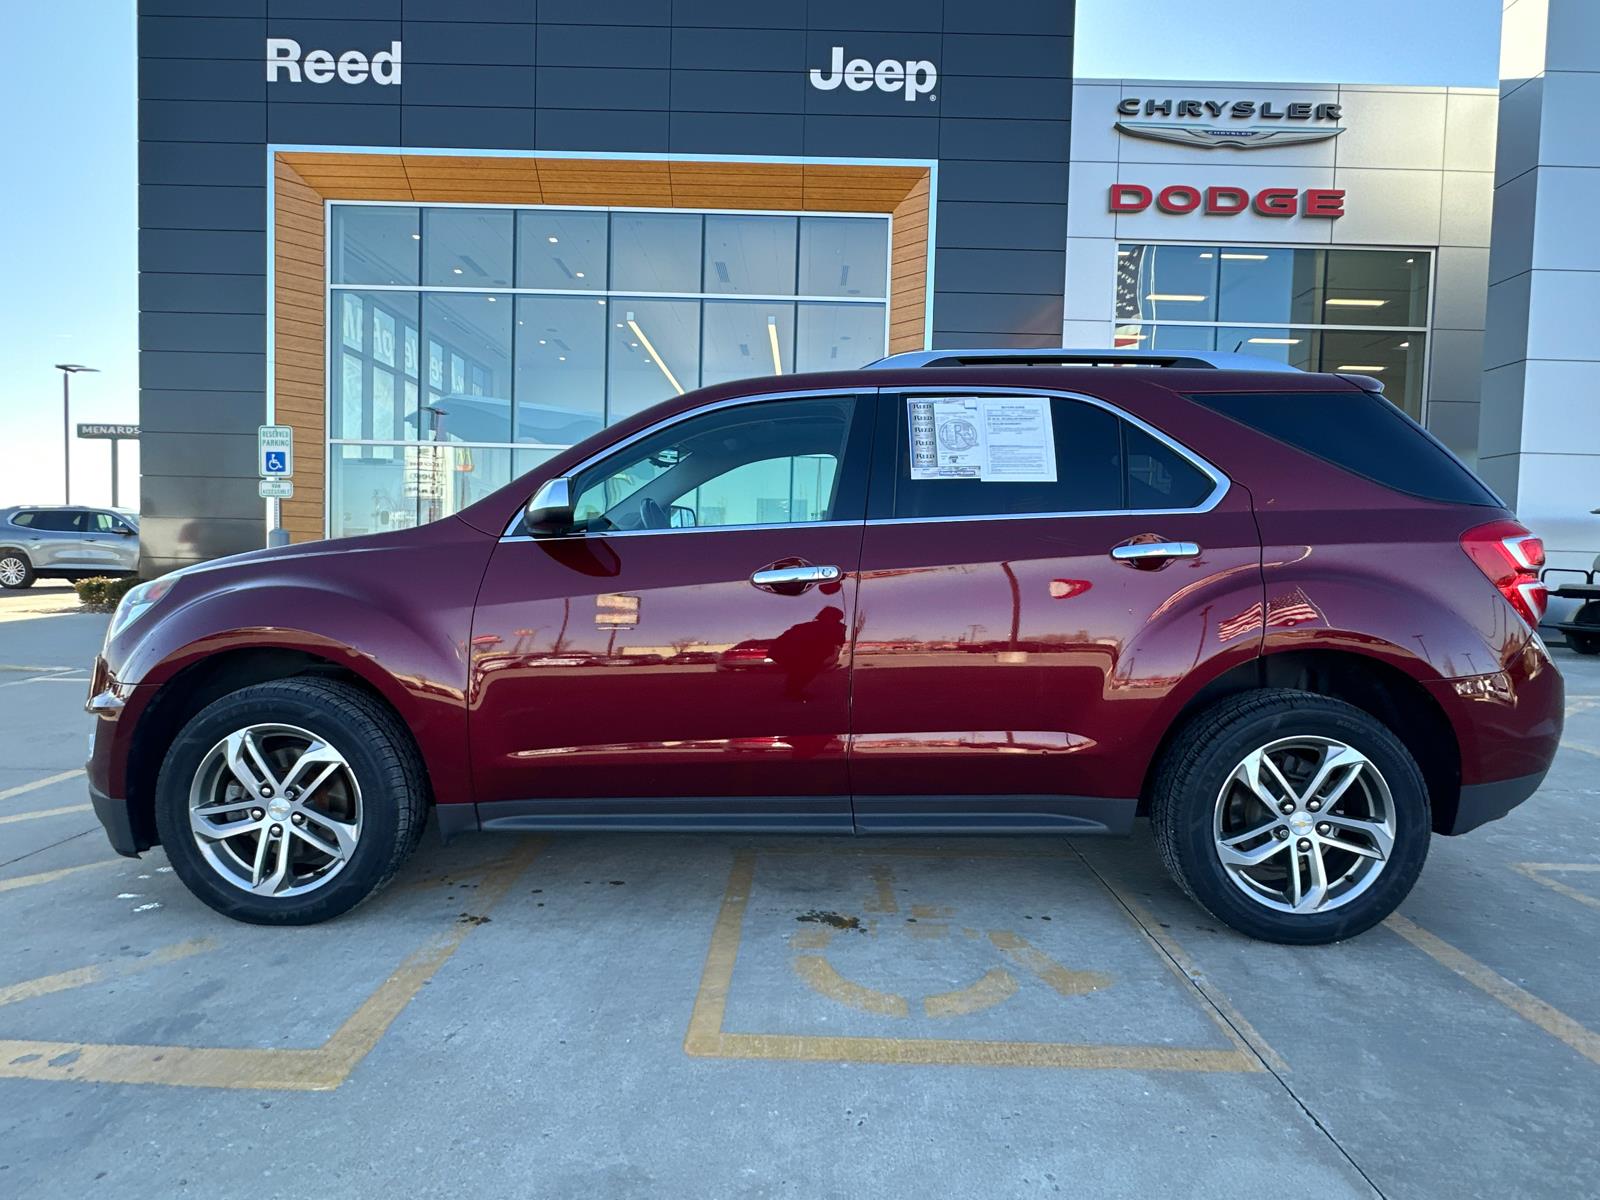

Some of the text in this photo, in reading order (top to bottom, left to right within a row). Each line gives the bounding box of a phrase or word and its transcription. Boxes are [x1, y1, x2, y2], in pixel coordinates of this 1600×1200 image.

[266, 38, 402, 85] Reed
[809, 46, 938, 102] Jeep
[1116, 98, 1345, 121] CHRYSLER
[1107, 183, 1346, 219] DODGE
[81, 425, 141, 434] MENARDS
[262, 430, 289, 438] RESERVED
[262, 439, 290, 447] PARKING
